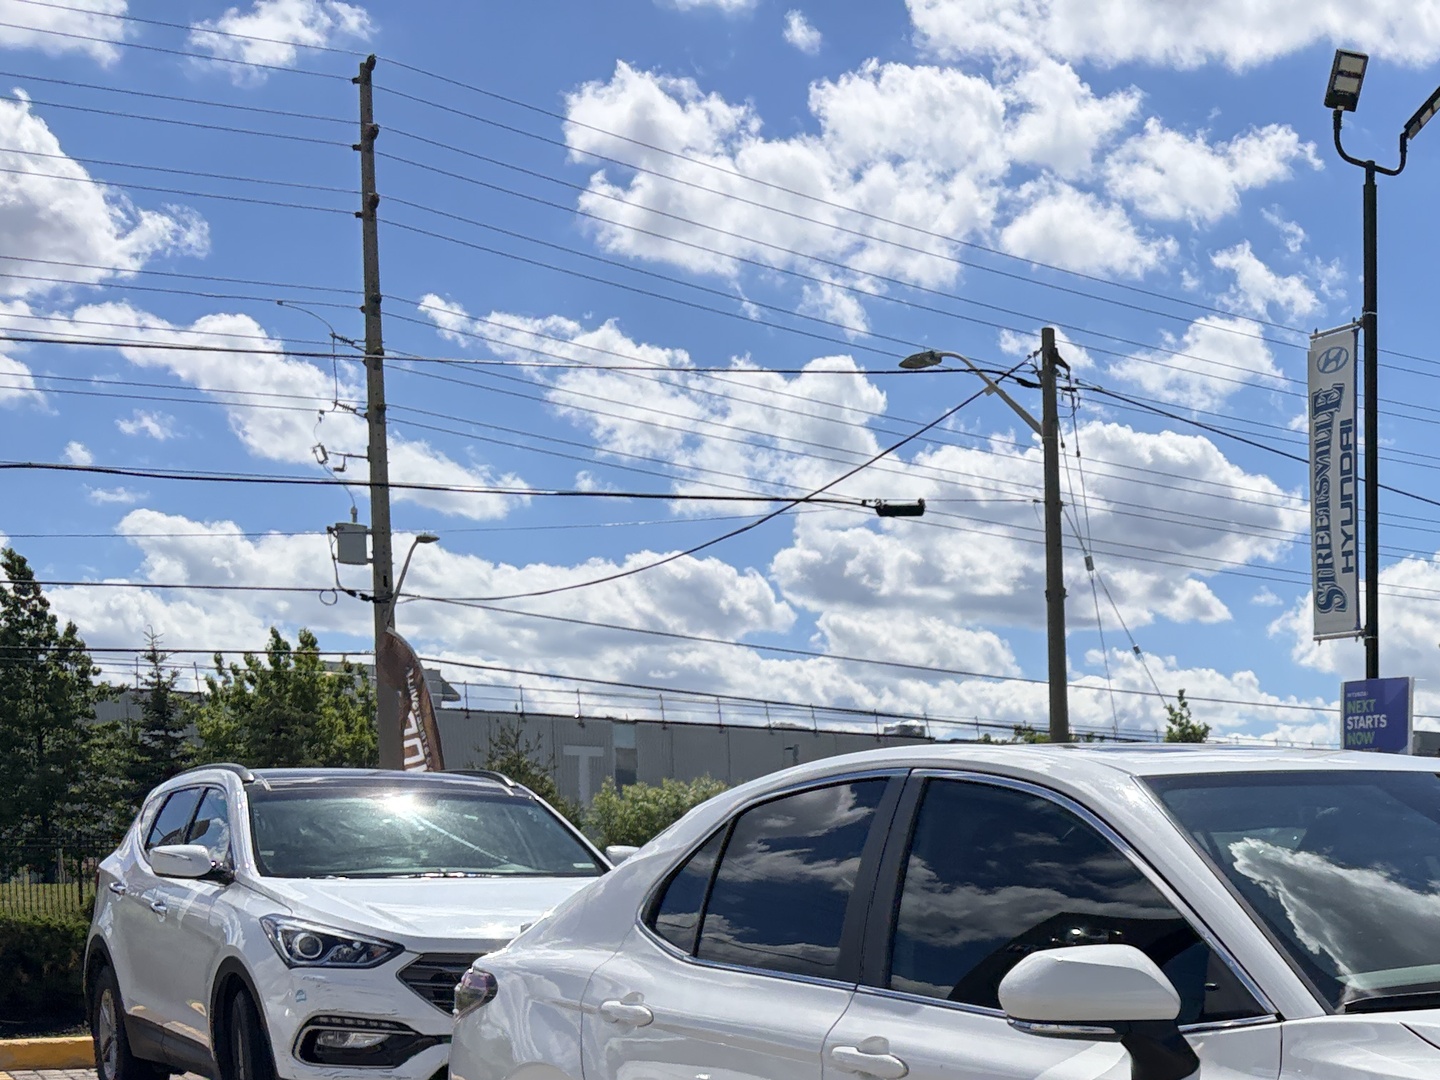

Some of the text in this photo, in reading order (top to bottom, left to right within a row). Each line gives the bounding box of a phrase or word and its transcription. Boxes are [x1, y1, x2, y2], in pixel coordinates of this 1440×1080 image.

[1339, 418, 1354, 574] HYUNDAI
[1347, 699, 1377, 714] NEXT
[1347, 714, 1387, 731] STARTS
[1347, 731, 1375, 746] NOW
